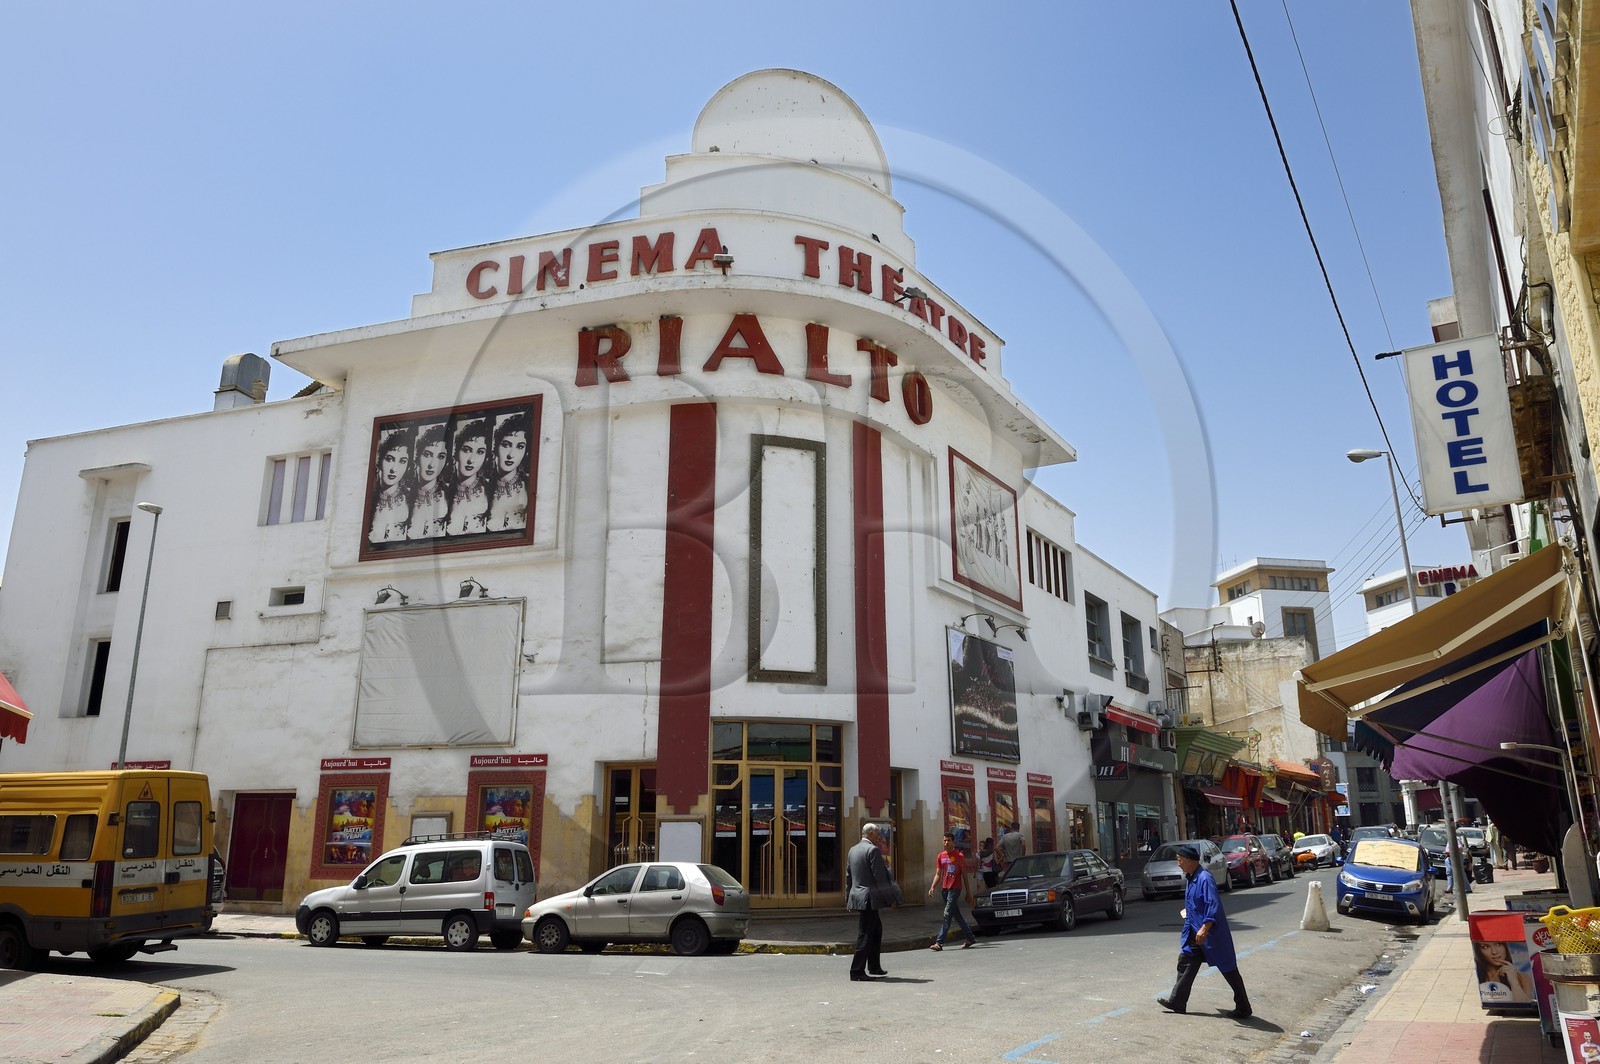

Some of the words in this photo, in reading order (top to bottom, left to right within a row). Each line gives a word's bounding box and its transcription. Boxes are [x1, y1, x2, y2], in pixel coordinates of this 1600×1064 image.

[466, 228, 732, 300] CINEMA
[795, 235, 988, 371] THEATRE
[574, 313, 933, 425] RIALTO
[1432, 349, 1489, 495] HOTEL
[1417, 563, 1479, 585] CINEMA
[323, 758, 358, 769] Aujourd'hui
[472, 755, 512, 766] Aujourd'hui
[46, 865, 71, 877] النقل
[1480, 990, 1507, 998] Pingouin
